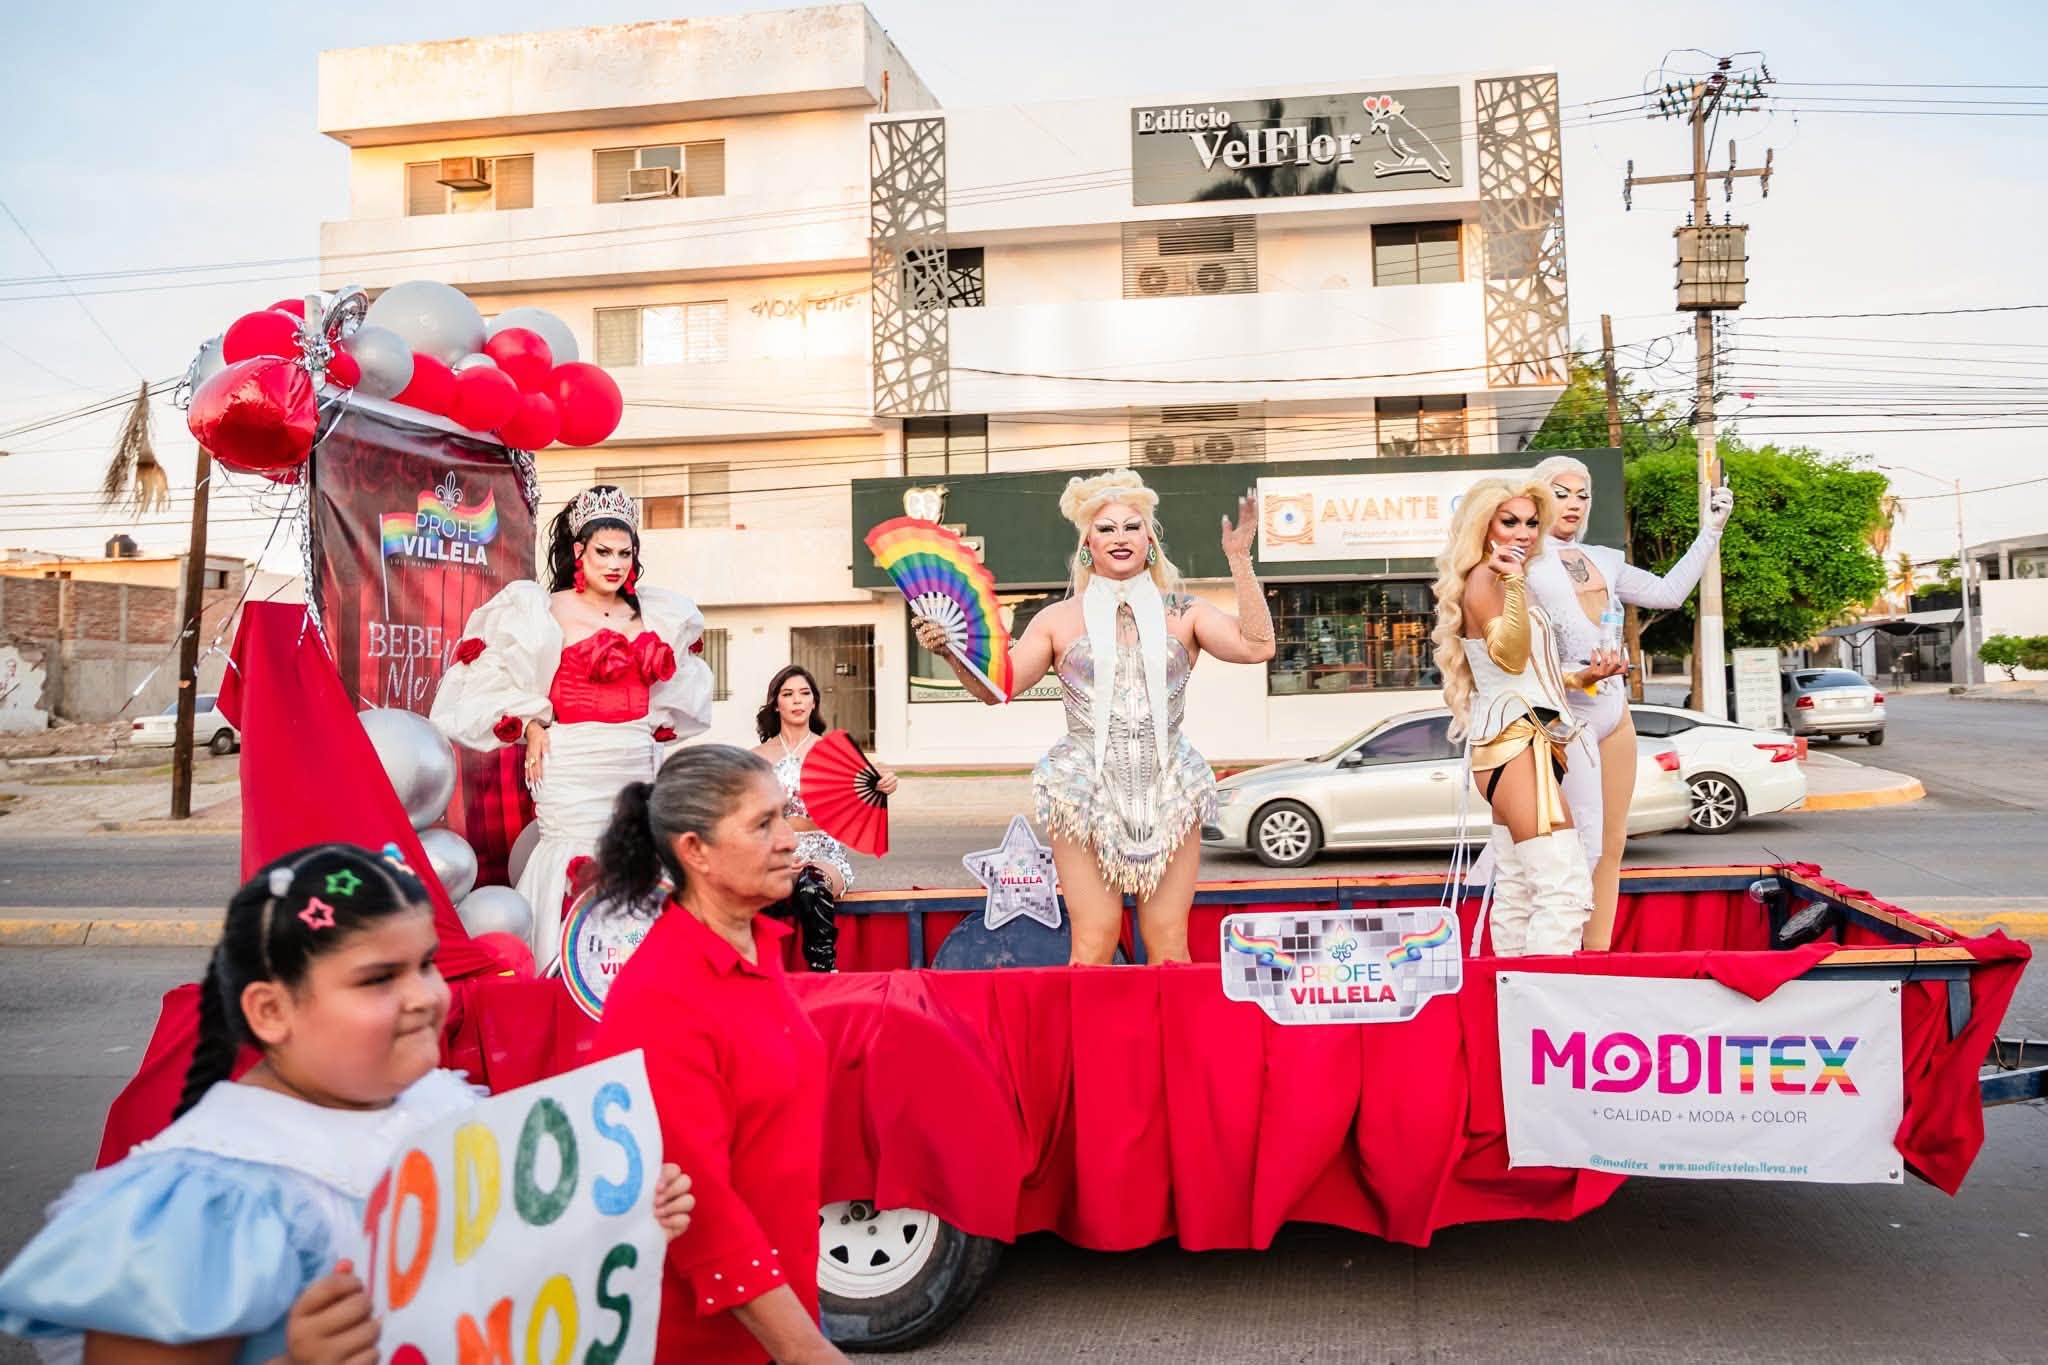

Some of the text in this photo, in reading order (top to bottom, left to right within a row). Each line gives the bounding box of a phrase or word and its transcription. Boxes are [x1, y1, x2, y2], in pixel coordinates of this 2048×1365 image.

[1137, 107, 1232, 134] Edificio
[1189, 126, 1361, 171] VelFlor
[1320, 494, 1440, 523] AVANTE
[415, 512, 480, 542] PROFE
[402, 534, 489, 566] VILLELA
[368, 621, 443, 658] BEBE
[1000, 875, 1043, 886] VILLELA
[1301, 963, 1382, 984] PROFE
[1290, 984, 1397, 1006] VILLELA
[1531, 1028, 1861, 1097] MODITEX
[1603, 1107, 1672, 1123] CALIDAD
[1688, 1110, 1735, 1123] MODA
[1751, 1110, 1808, 1124] COLOR
[1589, 1154, 1649, 1170] @moditex
